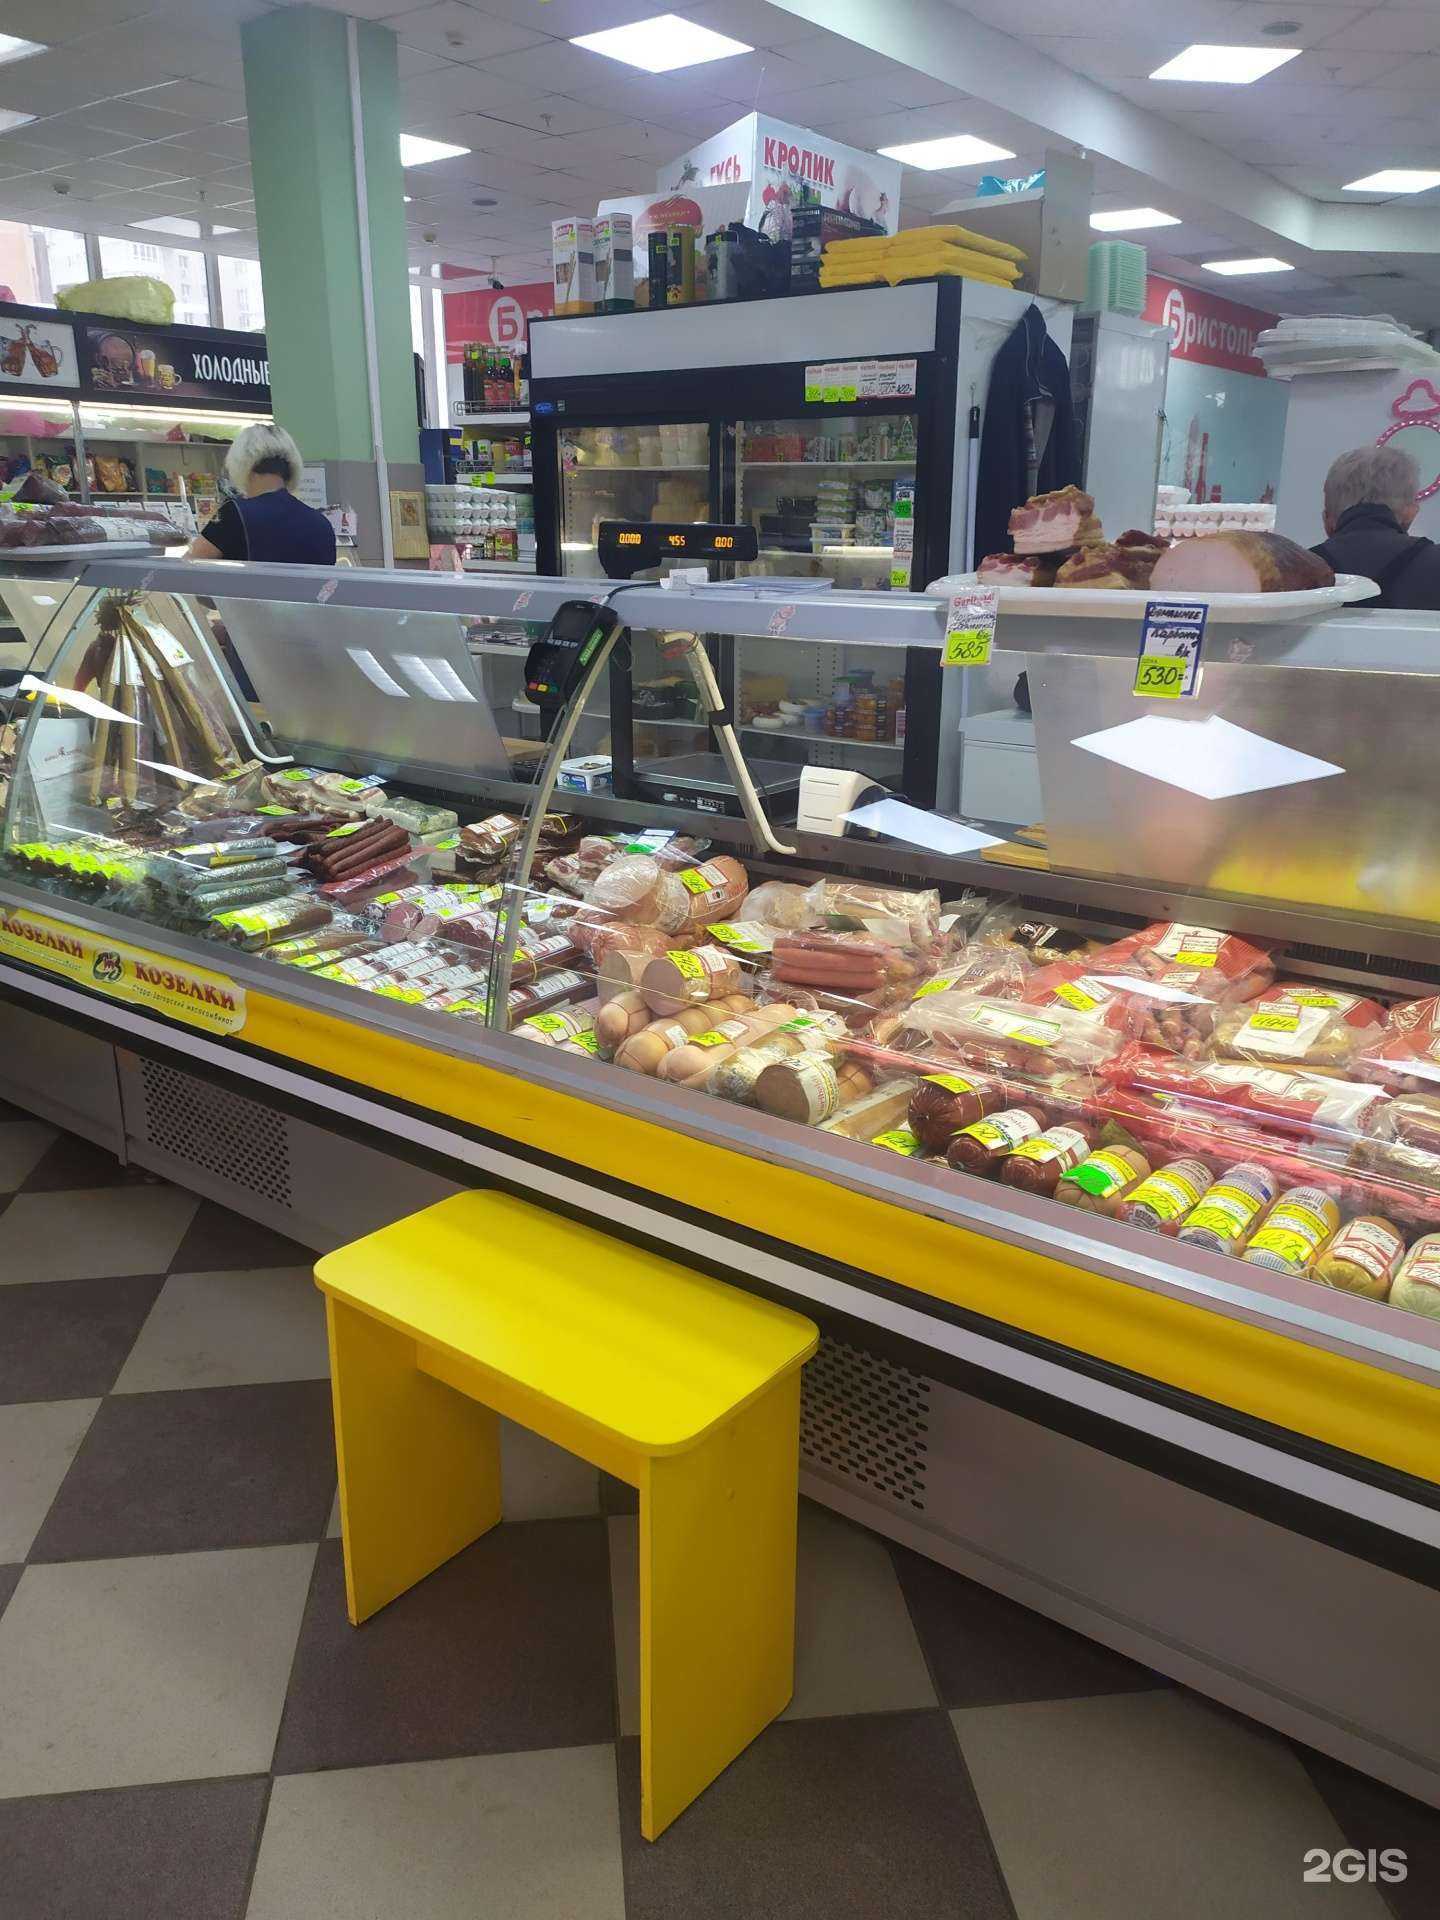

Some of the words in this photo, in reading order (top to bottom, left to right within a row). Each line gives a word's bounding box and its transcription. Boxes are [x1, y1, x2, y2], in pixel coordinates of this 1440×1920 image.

[763, 136, 835, 186] КРОЛИК
[192, 353, 271, 386] ХОЛОДНЫЕ
[949, 641, 984, 660] 585
[135, 961, 235, 1011] КОЗЕЛКИ
